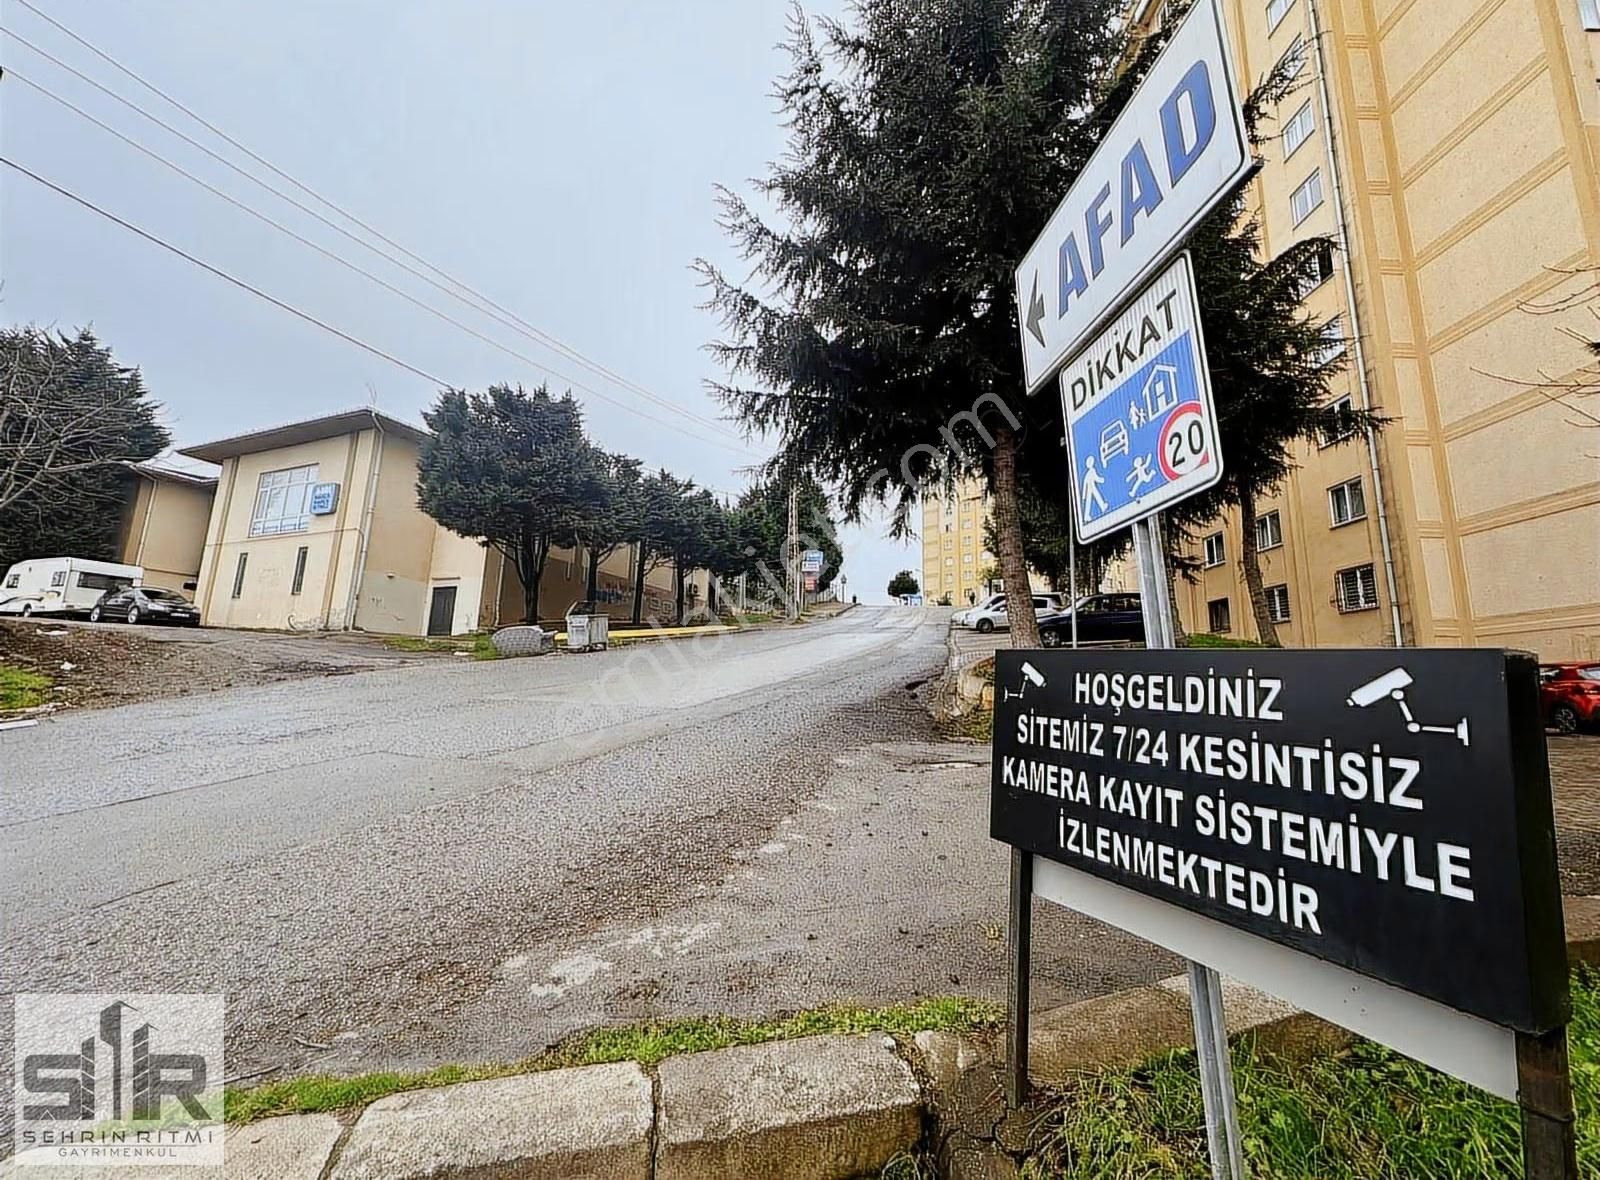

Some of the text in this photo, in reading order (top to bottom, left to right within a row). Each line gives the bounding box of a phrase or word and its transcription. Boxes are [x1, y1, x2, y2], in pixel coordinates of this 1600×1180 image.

[1057, 60, 1216, 320] AFAD
[1070, 288, 1178, 412] DİKKAT
[1170, 429, 1205, 469] 20
[1074, 667, 1284, 722] HOŞGELDİNİZ
[1016, 709, 1424, 810] SİTEMİZ 7/24 KESİNTİSİZ
[1002, 755, 1475, 902] KAMERA KAYIT SİSTEMİYLE
[1058, 808, 1322, 935] İZLENMEKTEDİR
